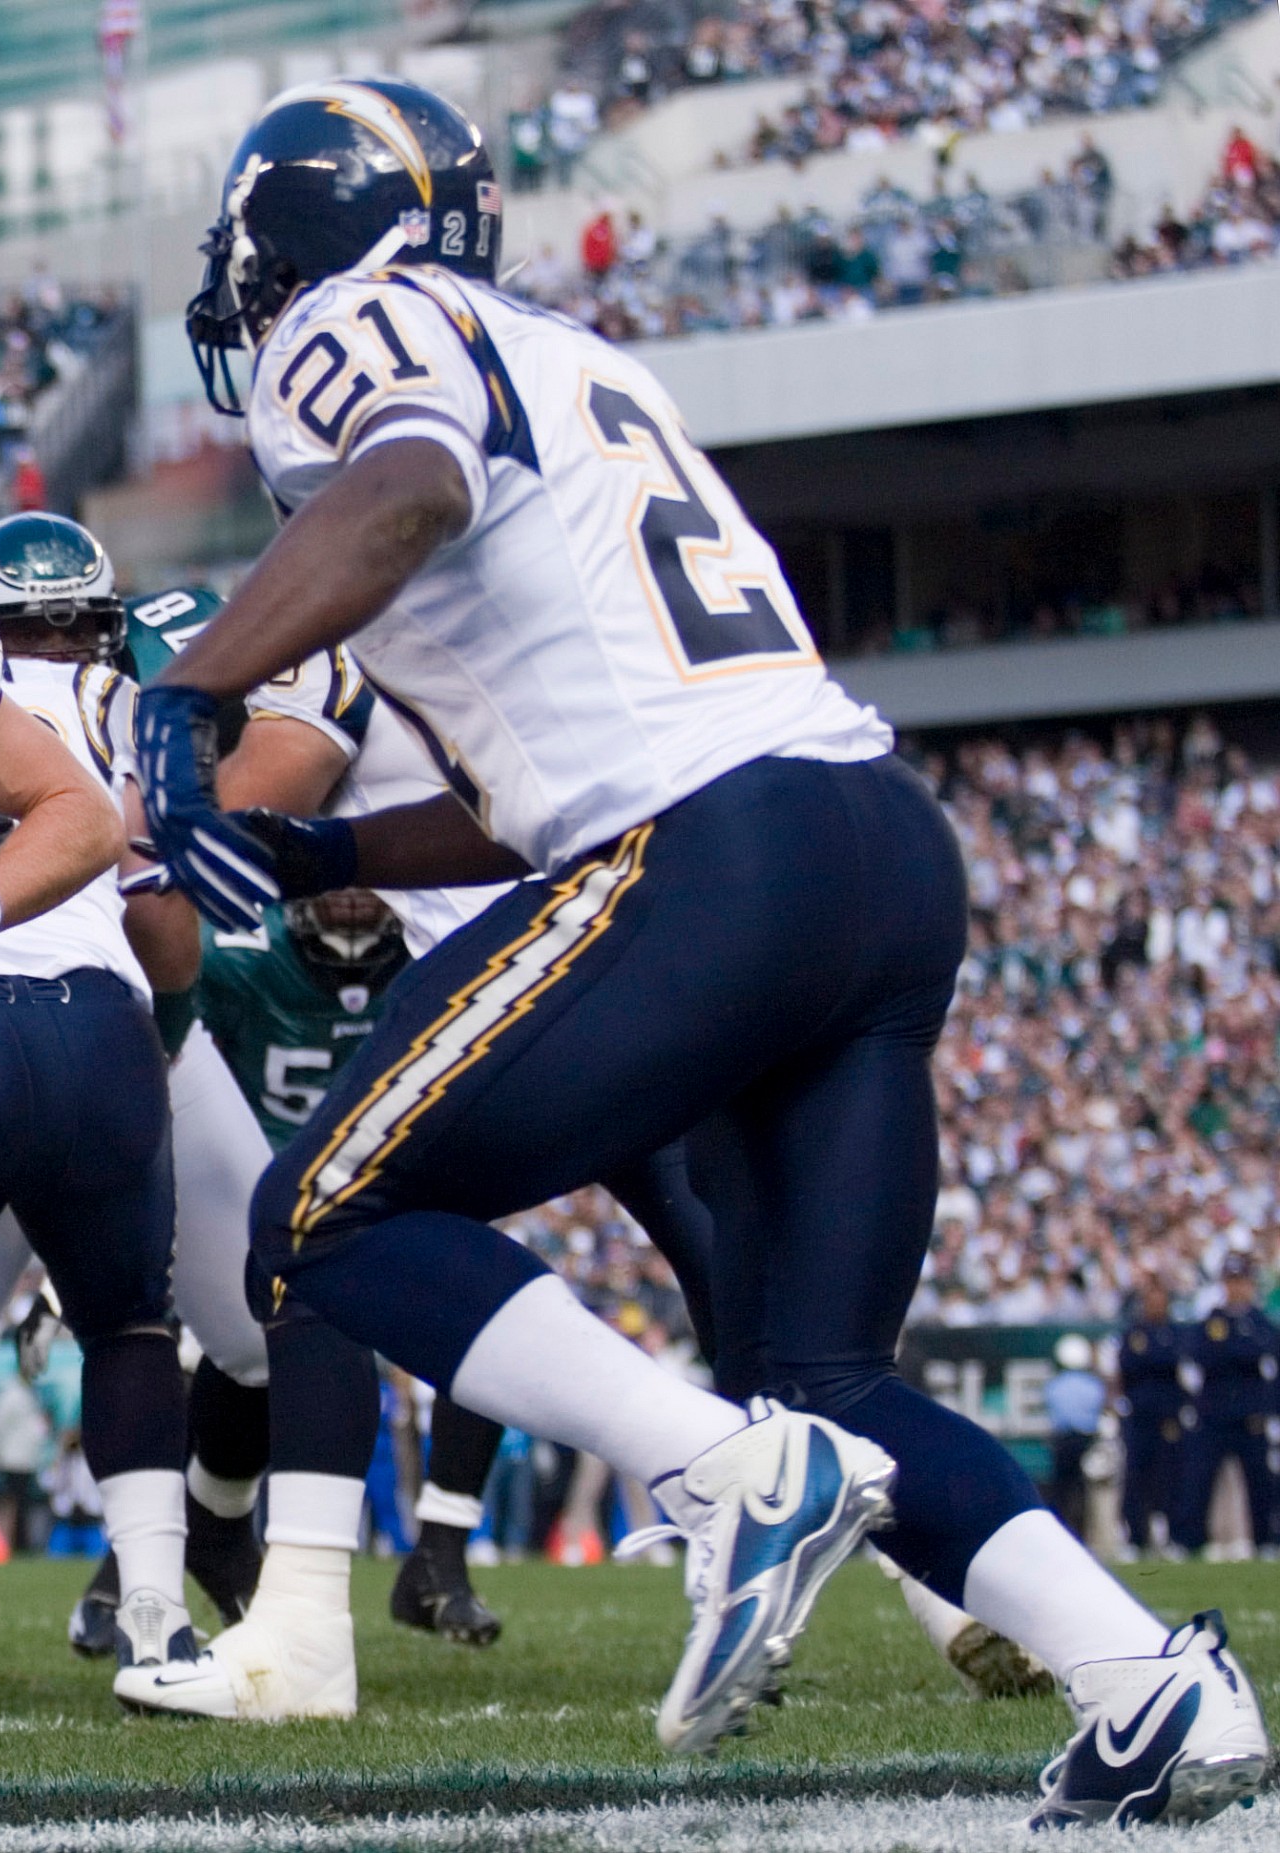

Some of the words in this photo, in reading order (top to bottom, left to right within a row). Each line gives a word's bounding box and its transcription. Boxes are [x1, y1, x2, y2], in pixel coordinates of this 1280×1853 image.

[440, 208, 491, 257] 21
[275, 294, 437, 455] 21
[577, 367, 824, 685] 2
